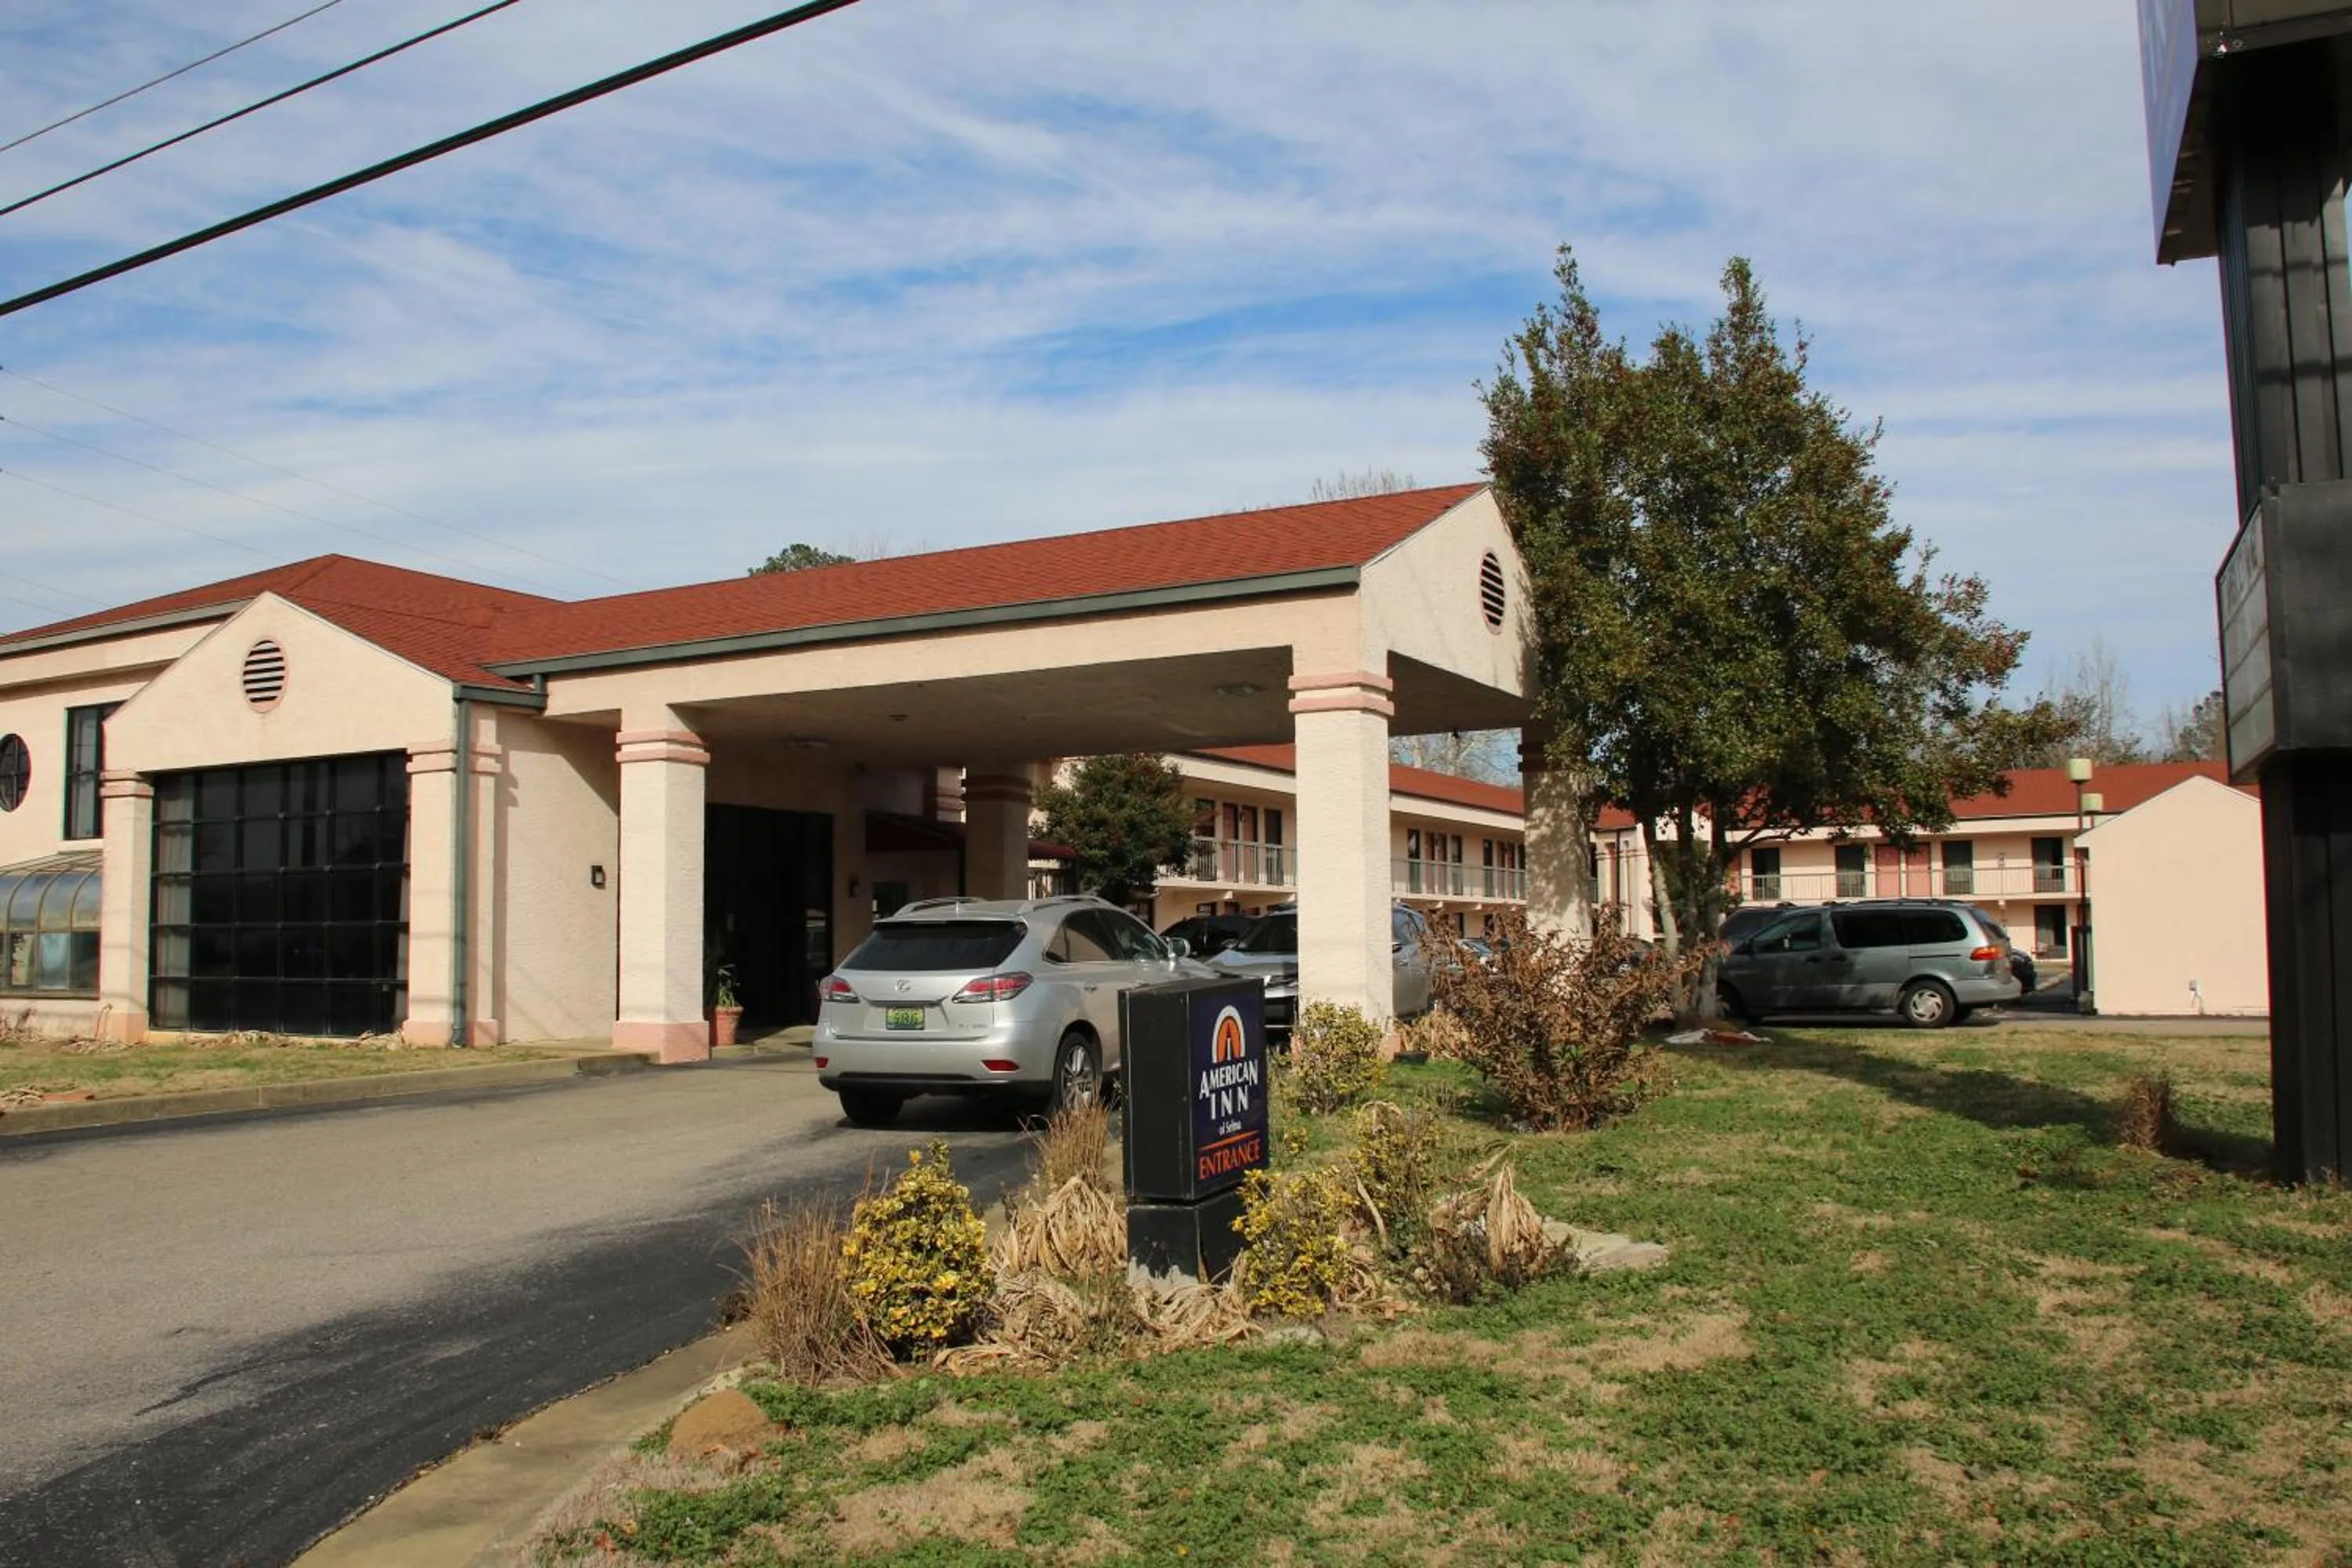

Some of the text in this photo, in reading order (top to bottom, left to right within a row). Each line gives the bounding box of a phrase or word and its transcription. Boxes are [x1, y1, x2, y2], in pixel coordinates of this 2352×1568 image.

[1199, 1058, 1258, 1099] AMERICAN
[1210, 1084, 1249, 1120] INN
[1200, 1139, 1261, 1179] ENTRANCE
